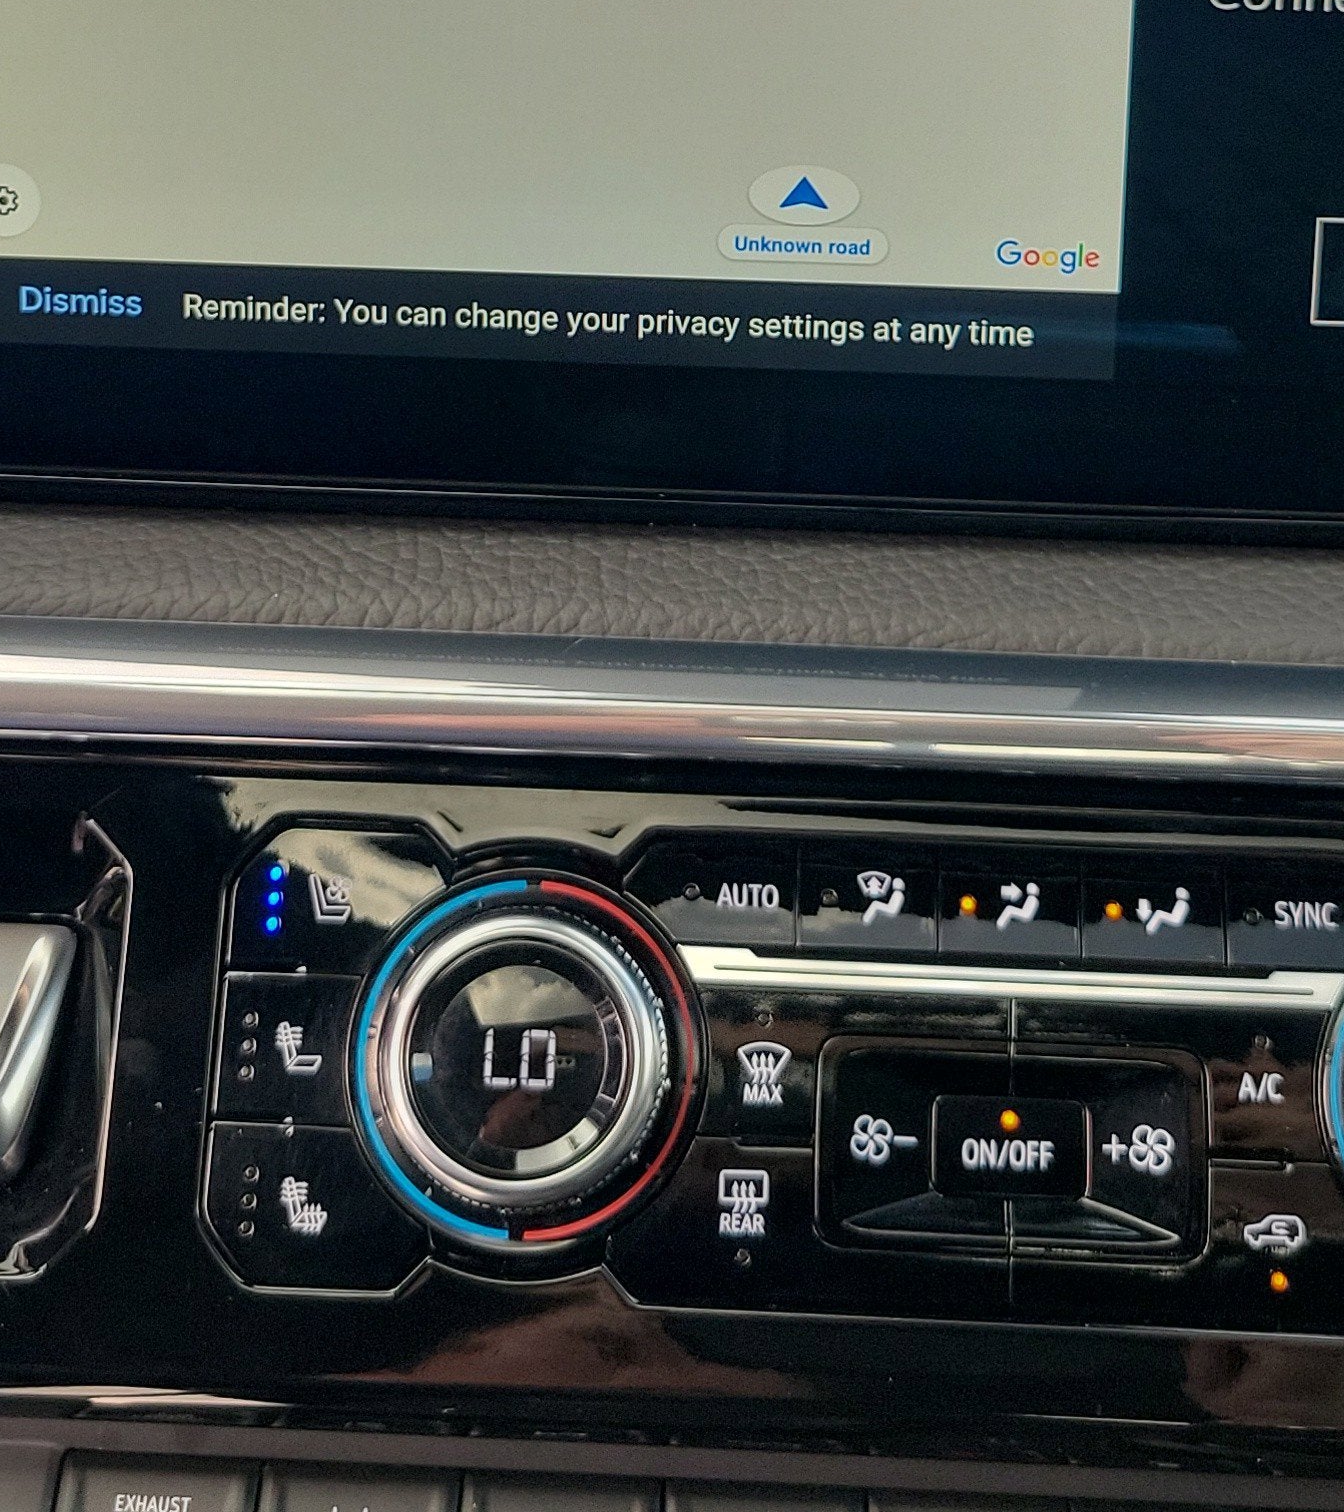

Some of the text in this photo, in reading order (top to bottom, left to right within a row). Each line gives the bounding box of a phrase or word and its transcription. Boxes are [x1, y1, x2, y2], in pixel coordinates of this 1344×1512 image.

[735, 235, 871, 256] Unknown road
[996, 240, 1100, 275] Google
[19, 285, 143, 319] Dismiss
[183, 293, 1036, 350] Reminder: You can change your privacy settings at any time
[717, 882, 780, 909] AUTO
[1274, 900, 1340, 931] SYNC
[743, 1082, 784, 1107] MAX
[1238, 1071, 1286, 1105] A/C
[961, 1138, 1056, 1172] ON/OFF
[719, 1212, 766, 1236] REAR
[114, 1493, 193, 1512] EXHAUST
